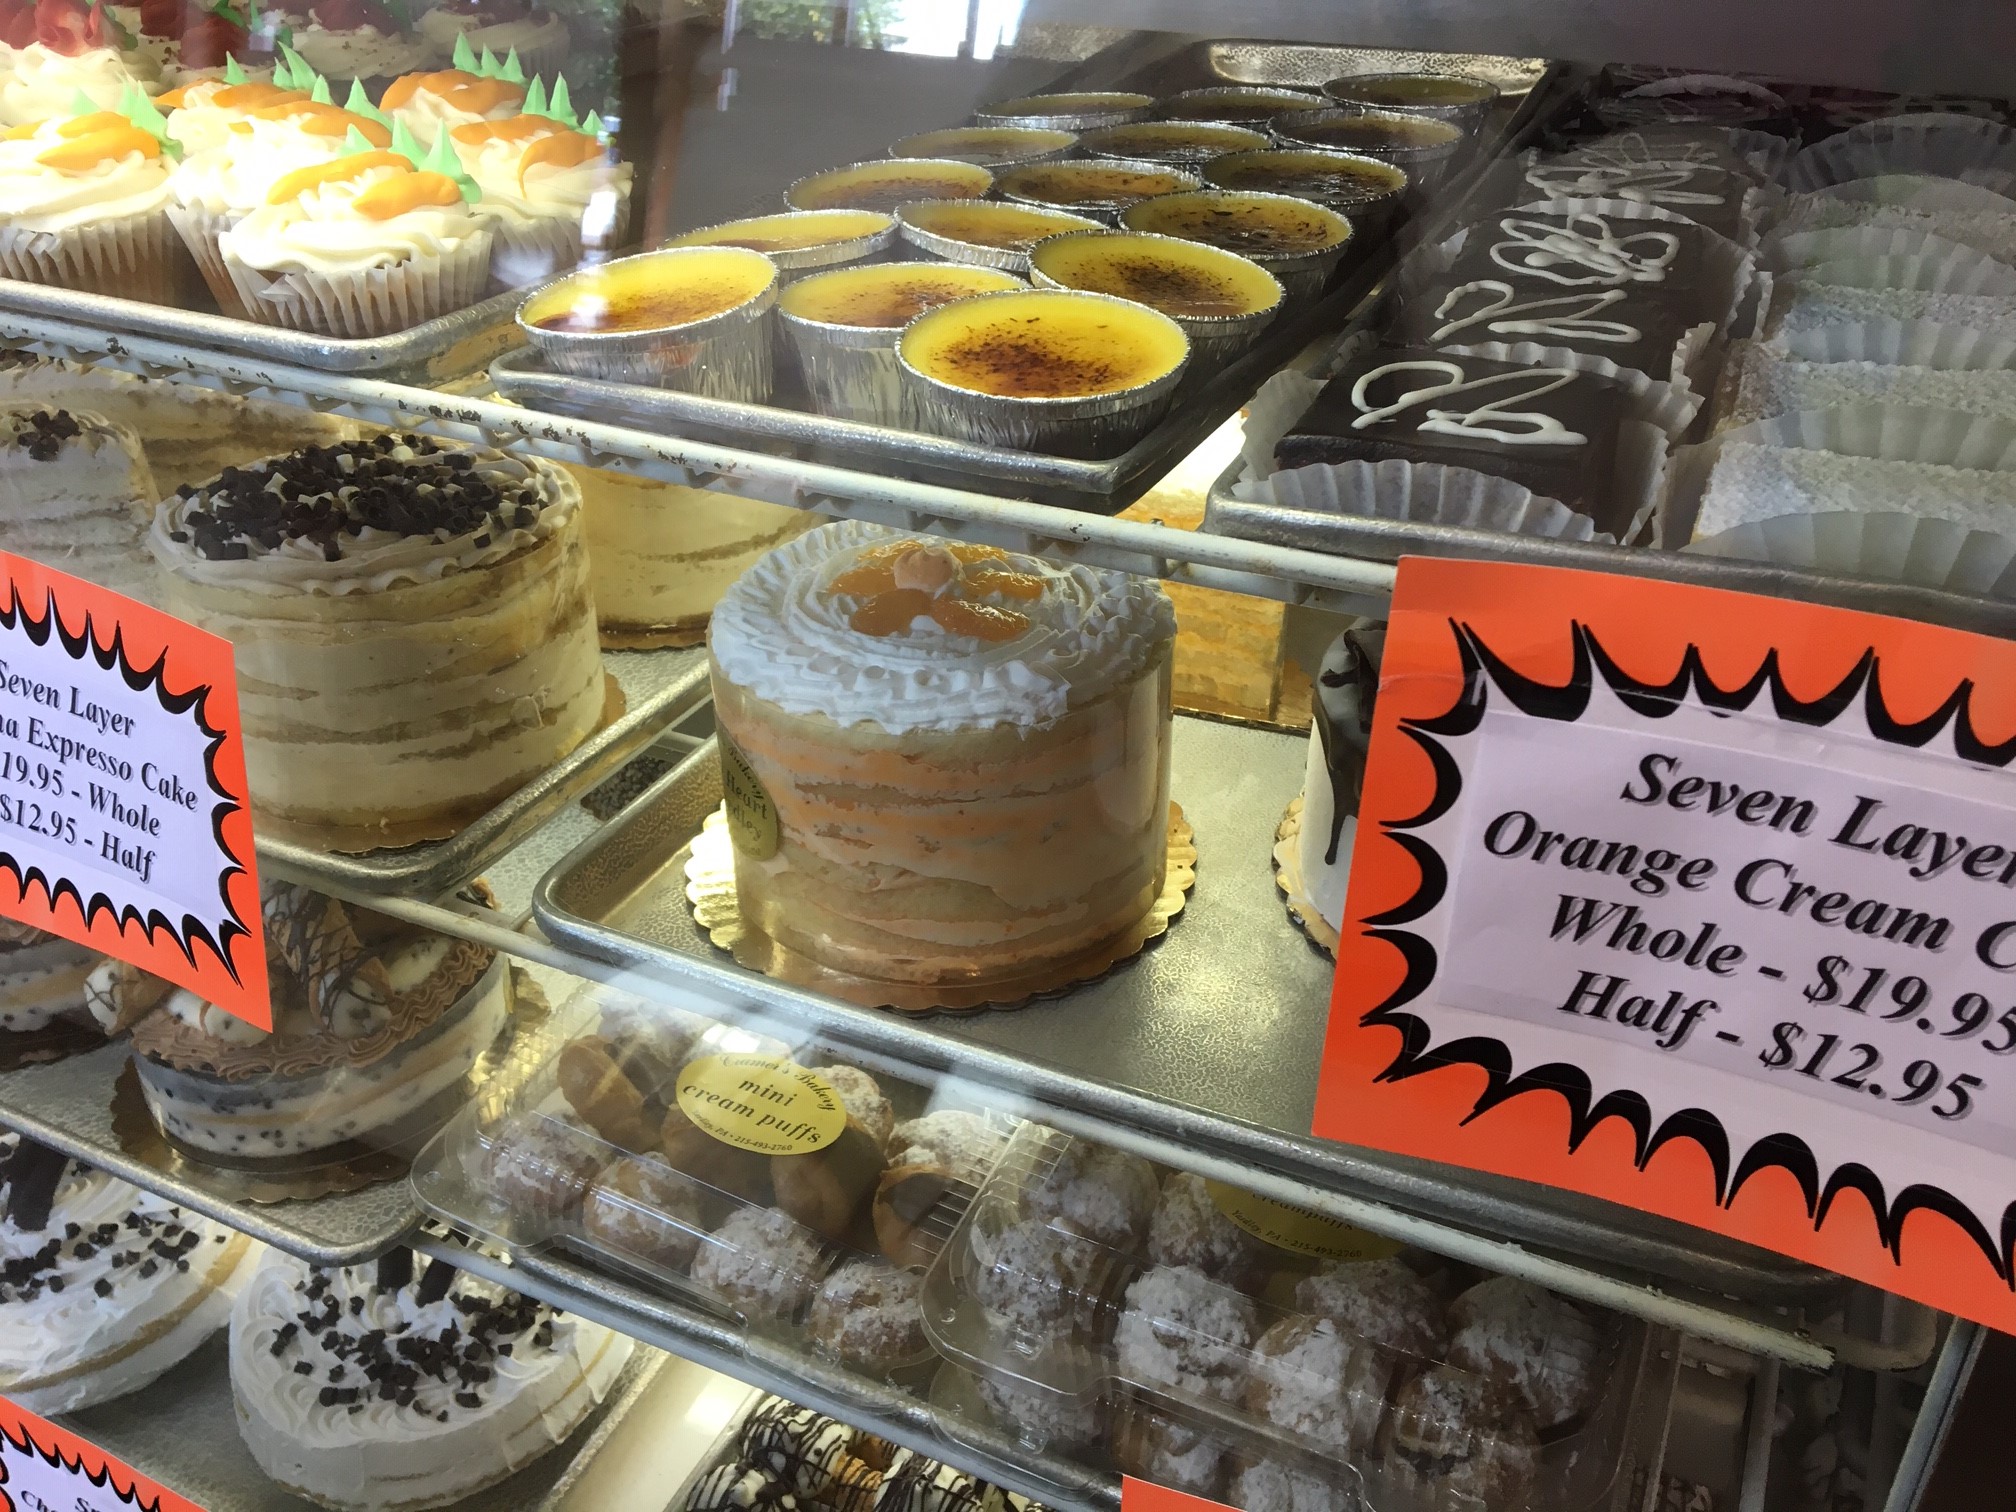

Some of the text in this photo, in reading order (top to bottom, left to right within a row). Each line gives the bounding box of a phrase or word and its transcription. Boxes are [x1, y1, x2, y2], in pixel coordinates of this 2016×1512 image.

[0, 659, 135, 736] Seven Layer
[27, 716, 132, 781] Expresso
[141, 762, 198, 811] Cake
[1621, 753, 1814, 835] Seven
[0, 793, 76, 845] $12.95
[100, 830, 156, 882] Half
[88, 781, 161, 836] Whole
[1483, 810, 1715, 895] Orange
[1734, 858, 1954, 950] Cream
[1549, 894, 1744, 975] Whole
[1803, 955, 2016, 1053] $19.95
[1557, 969, 1717, 1050] Half
[1759, 1022, 1983, 1120] $12.95
[682, 1084, 821, 1144] cream puffs
[738, 1079, 798, 1107] mini
[794, 1073, 836, 1112] Bakery
[1290, 1240, 1362, 1258] 215-493-2760
